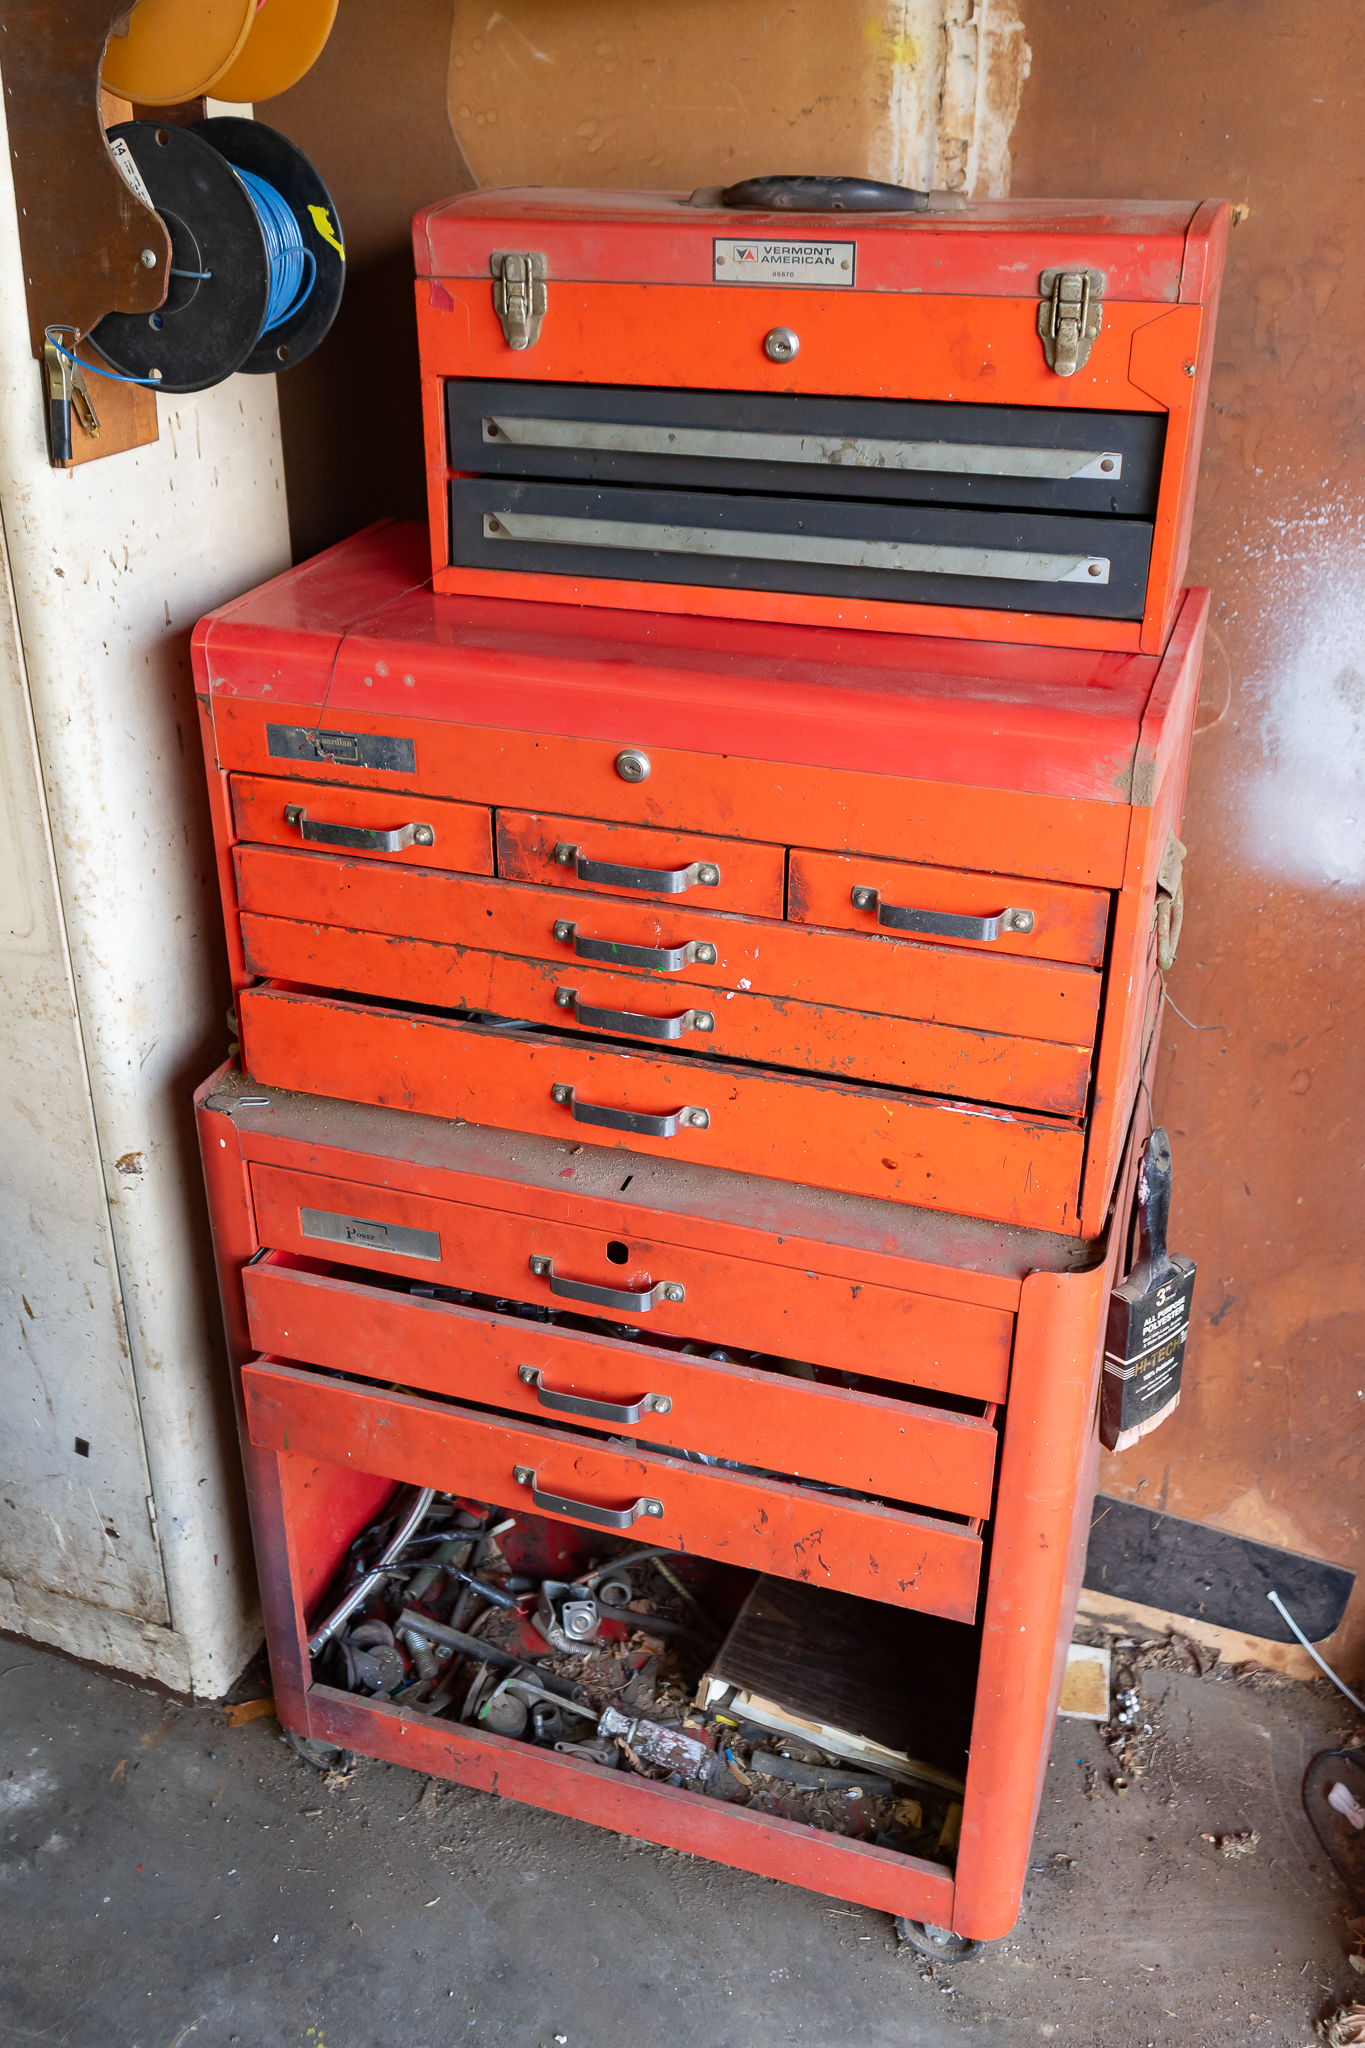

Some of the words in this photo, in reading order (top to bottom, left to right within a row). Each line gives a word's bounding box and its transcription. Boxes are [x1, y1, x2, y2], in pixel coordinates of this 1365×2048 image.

[115, 142, 126, 156] 14
[760, 255, 835, 265] AMERICAN
[763, 246, 833, 256] VERMONT
[1155, 1287, 1167, 1307] 3
[1142, 1303, 1185, 1337] POLYESTER
[1143, 1314, 1158, 1328] ALL
[1157, 1295, 1186, 1320] PURPOSE
[1134, 1335, 1181, 1377] HI-TECH
